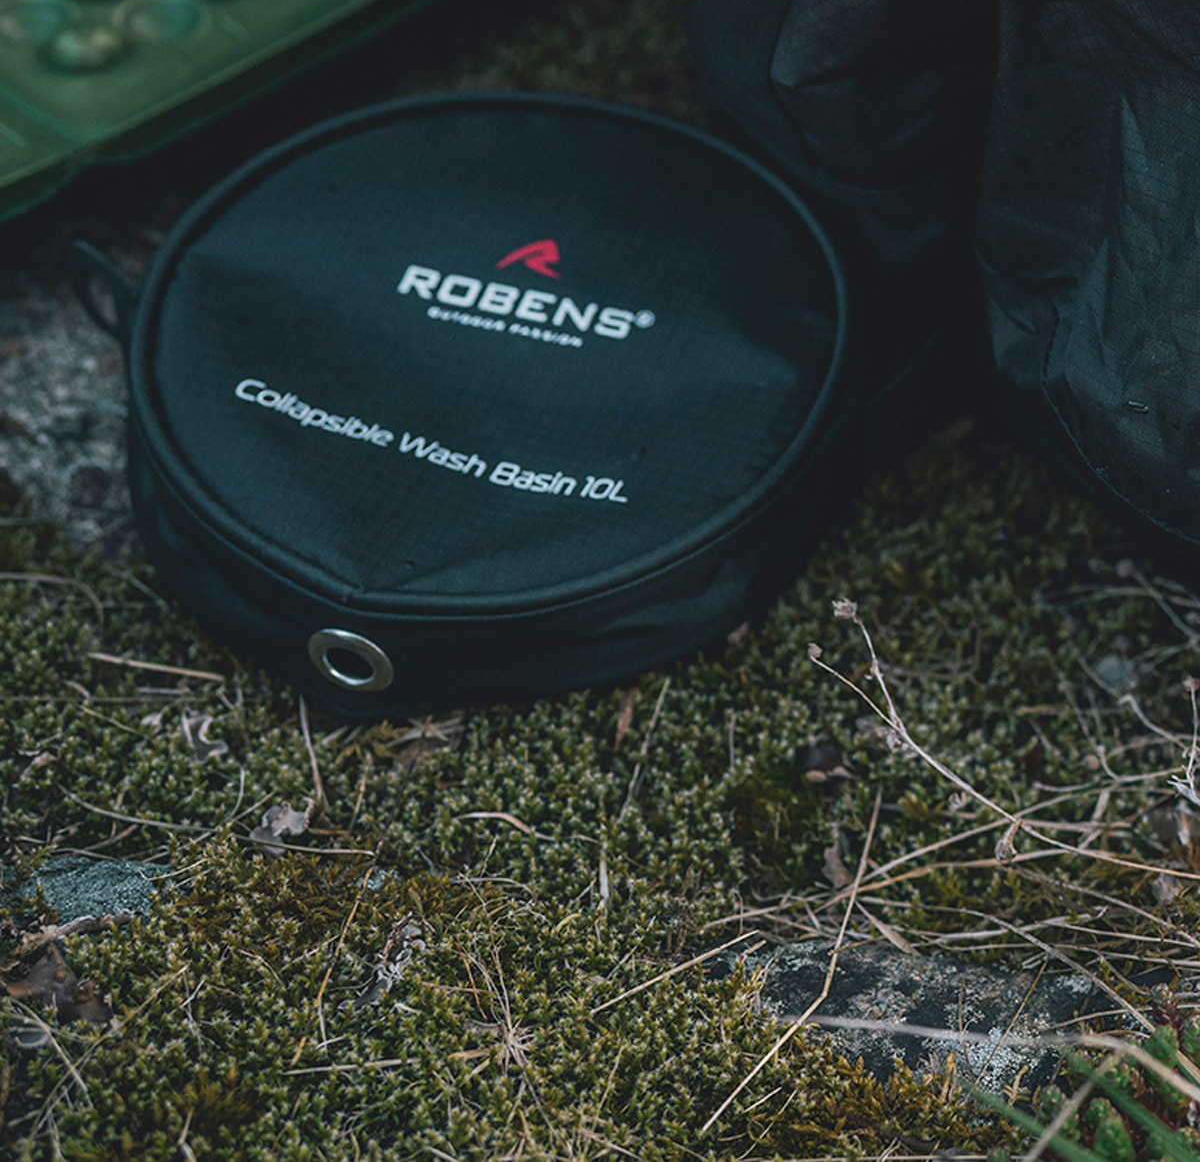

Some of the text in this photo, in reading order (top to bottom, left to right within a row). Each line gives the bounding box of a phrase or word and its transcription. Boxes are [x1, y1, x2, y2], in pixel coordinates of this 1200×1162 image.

[234, 379, 628, 503] Collapsible Wash Basin 10L
